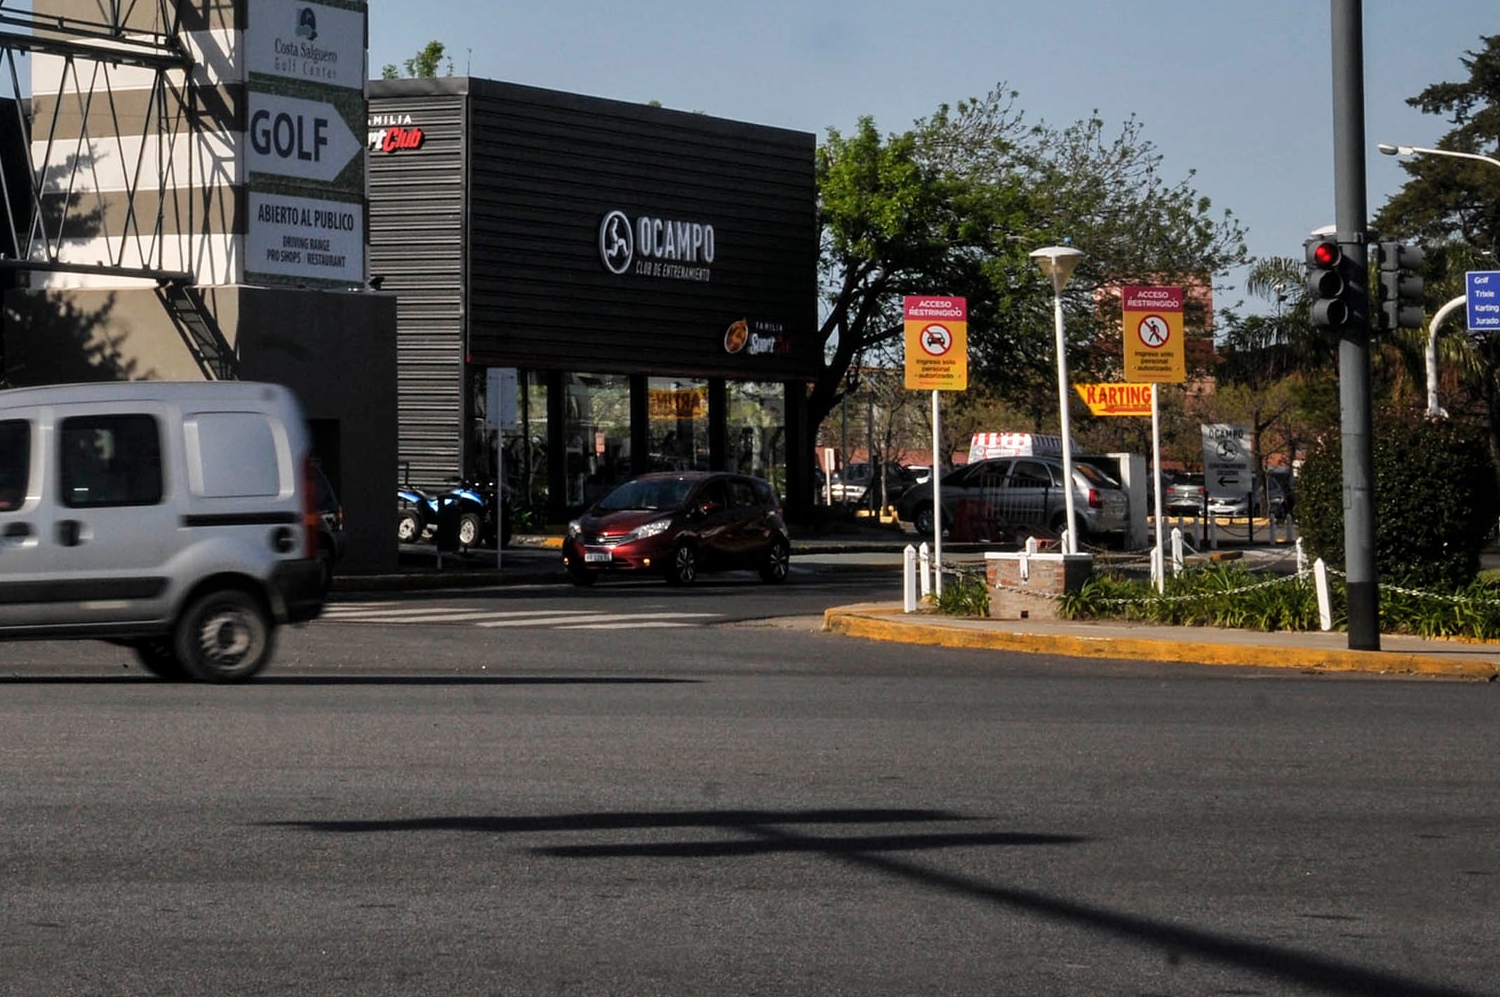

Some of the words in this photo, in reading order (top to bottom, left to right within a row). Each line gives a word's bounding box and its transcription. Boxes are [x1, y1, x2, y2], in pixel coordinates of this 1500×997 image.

[274, 37, 298, 58] Costa
[300, 41, 337, 64] Salguero
[250, 109, 328, 162] GOLF
[258, 204, 299, 225] ABIERTO
[301, 209, 313, 226] AL
[314, 210, 354, 231] PUBLICO
[637, 216, 714, 263] OCAMPO
[267, 248, 280, 262] PRO
[280, 250, 301, 264] SHOPS
[1140, 291, 1169, 299] ACCESO
[919, 300, 952, 308] ACCESO
[1127, 299, 1179, 308] RESTRINGIDO
[1475, 305, 1499, 313] Karting
[908, 308, 963, 317] RESTRINGIDO
[1087, 386, 1152, 404] KARTING
[1209, 429, 1244, 440] OCAMPO
